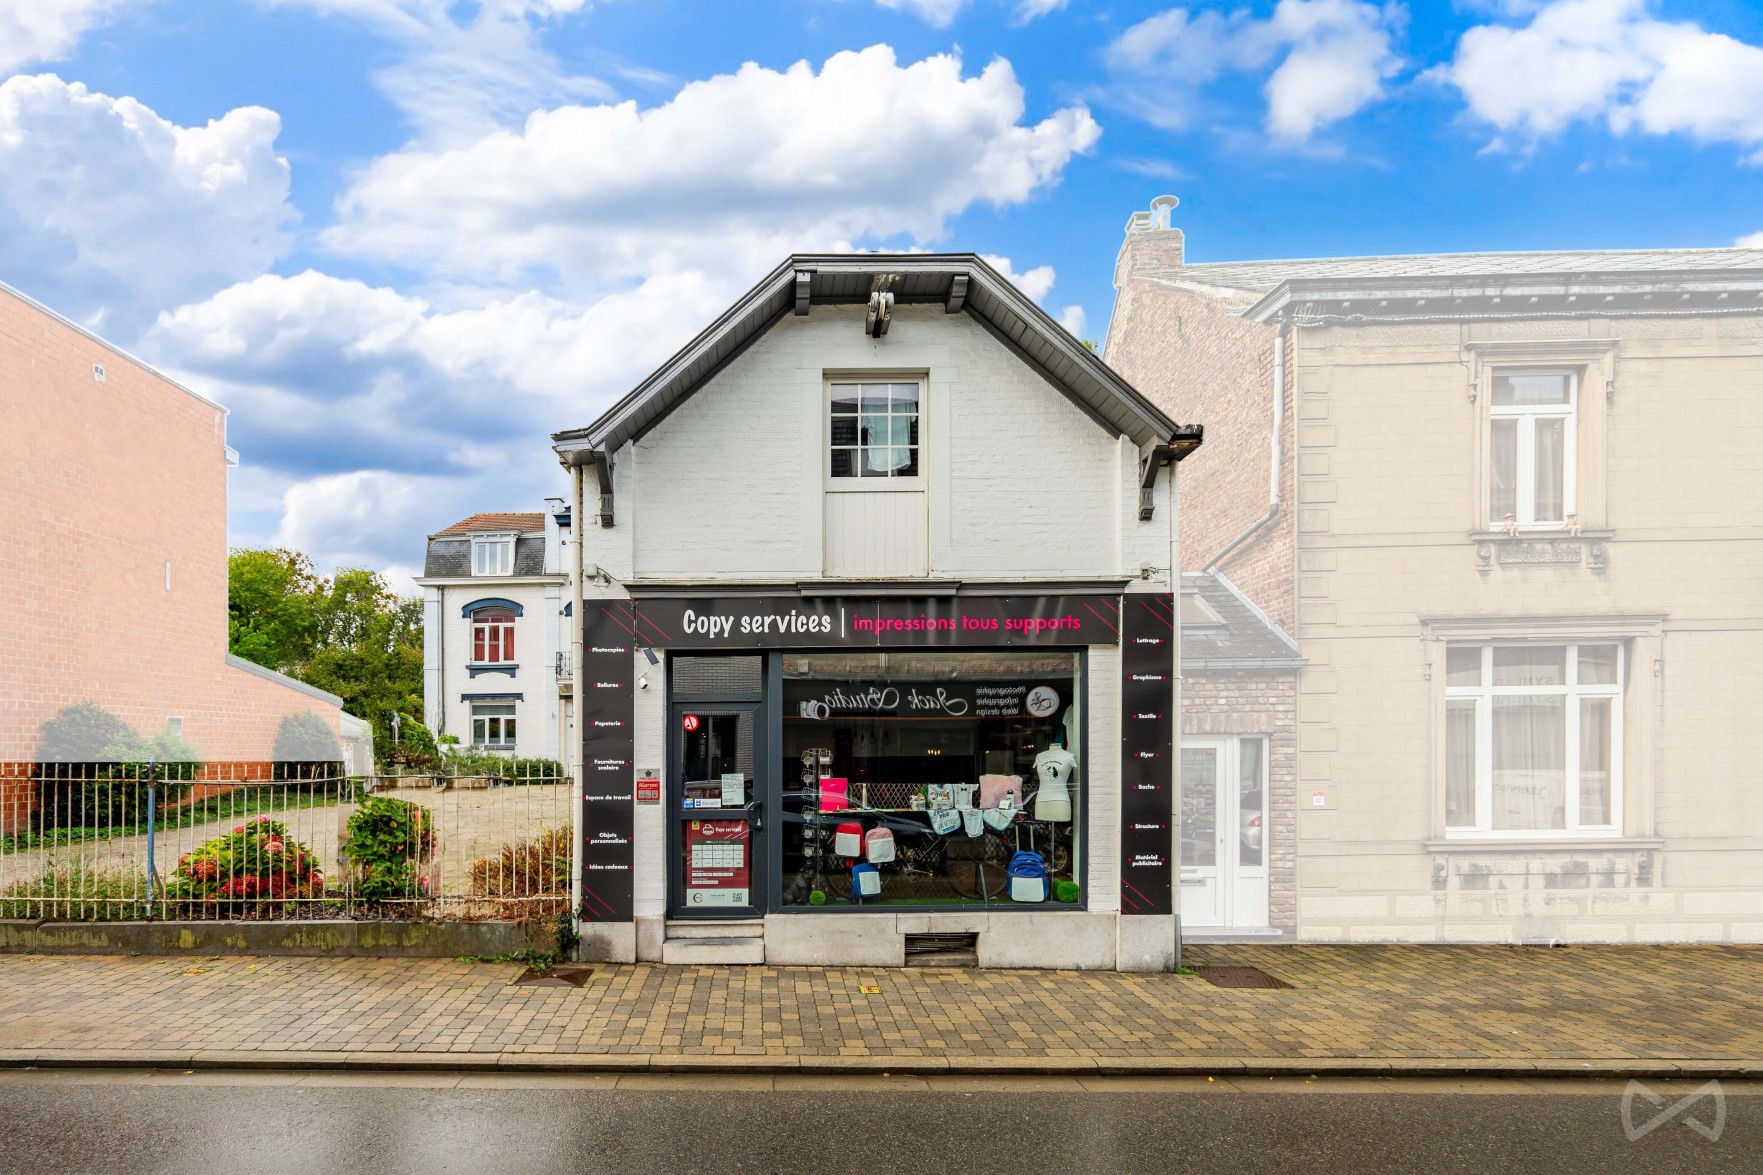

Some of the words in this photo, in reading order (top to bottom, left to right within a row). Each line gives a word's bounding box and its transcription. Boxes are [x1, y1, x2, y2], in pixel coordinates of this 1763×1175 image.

[683, 609, 734, 639] Copy
[740, 609, 831, 634] services
[853, 614, 957, 636] impressions
[962, 615, 999, 631] tous
[1004, 614, 1081, 635] supports
[591, 646, 625, 654] Photocopies
[1132, 674, 1162, 682] Graphisme
[594, 720, 621, 728] Papeterie
[1140, 751, 1155, 759] Flyer
[1132, 860, 1163, 868] publicitaire
